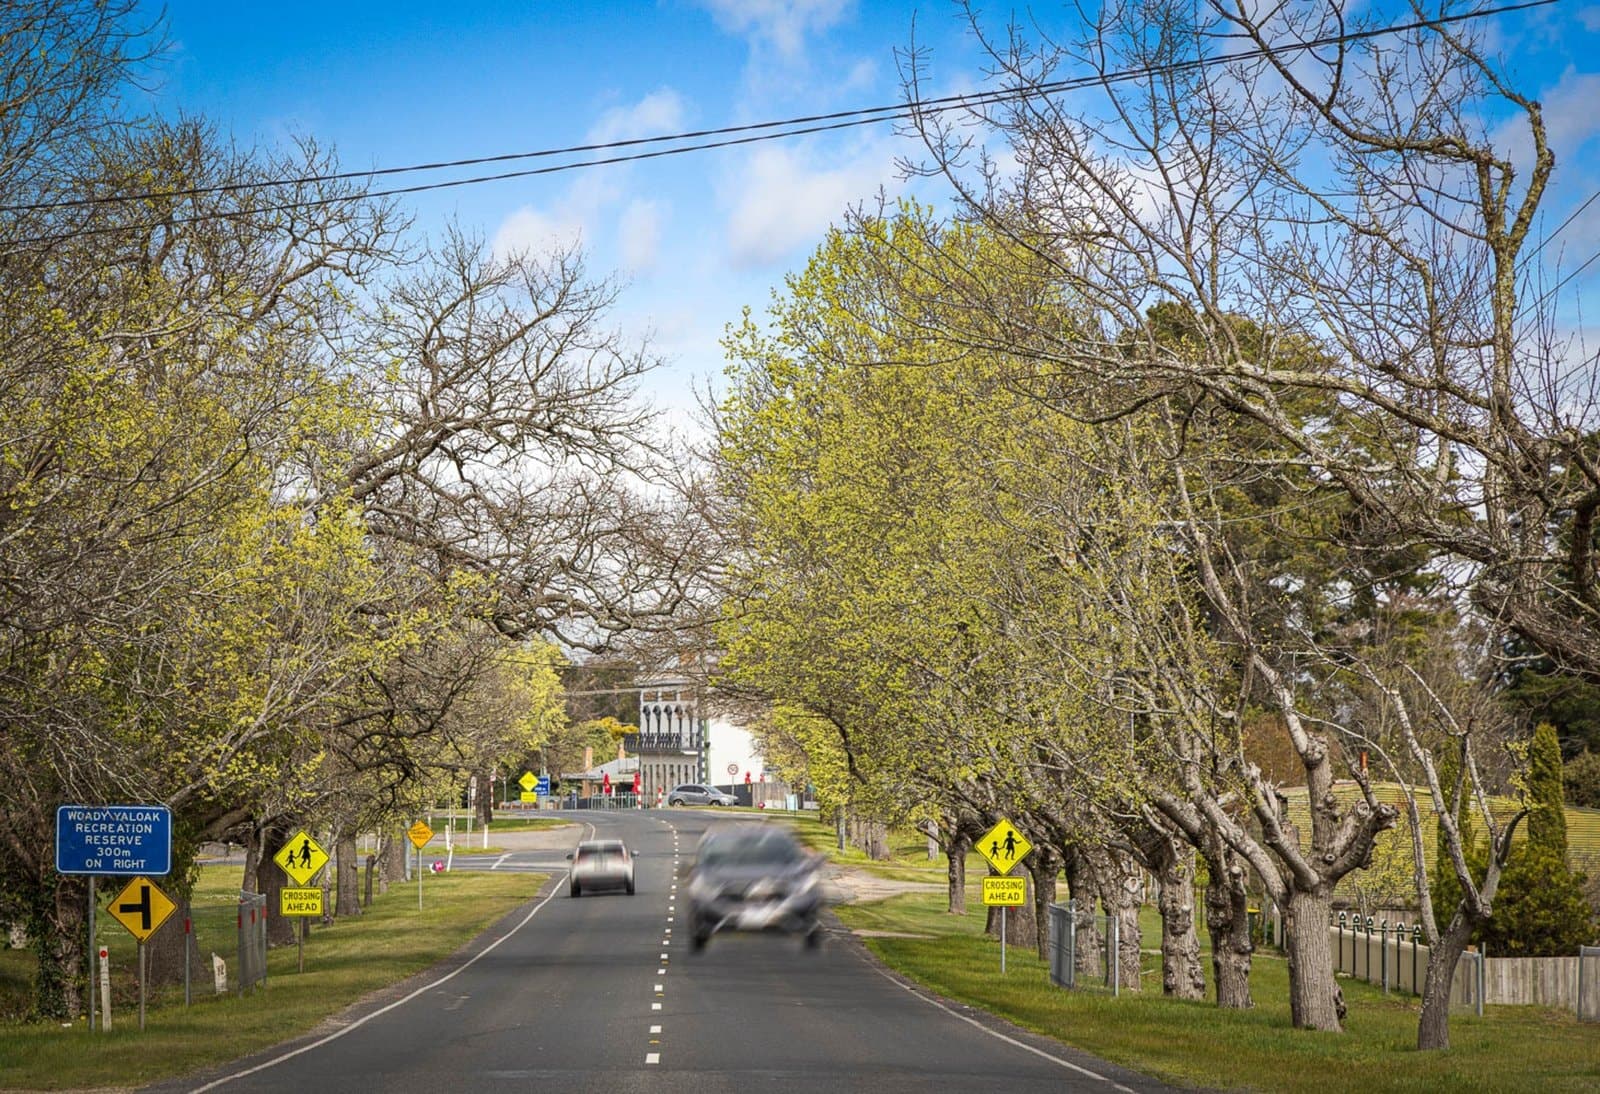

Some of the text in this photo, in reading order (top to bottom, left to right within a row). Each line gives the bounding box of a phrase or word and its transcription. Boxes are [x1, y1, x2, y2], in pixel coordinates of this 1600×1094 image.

[67, 811, 160, 822] WOADY YALOAK
[75, 823, 152, 834] RECREATION
[85, 835, 142, 845] RESERVE
[97, 847, 131, 857] 300m
[85, 859, 146, 869] ON RIGHT
[985, 880, 1023, 890] CROSSING
[283, 891, 321, 900] CROSSING
[989, 892, 1020, 901] AHEAD
[286, 903, 317, 911] AHEAD
